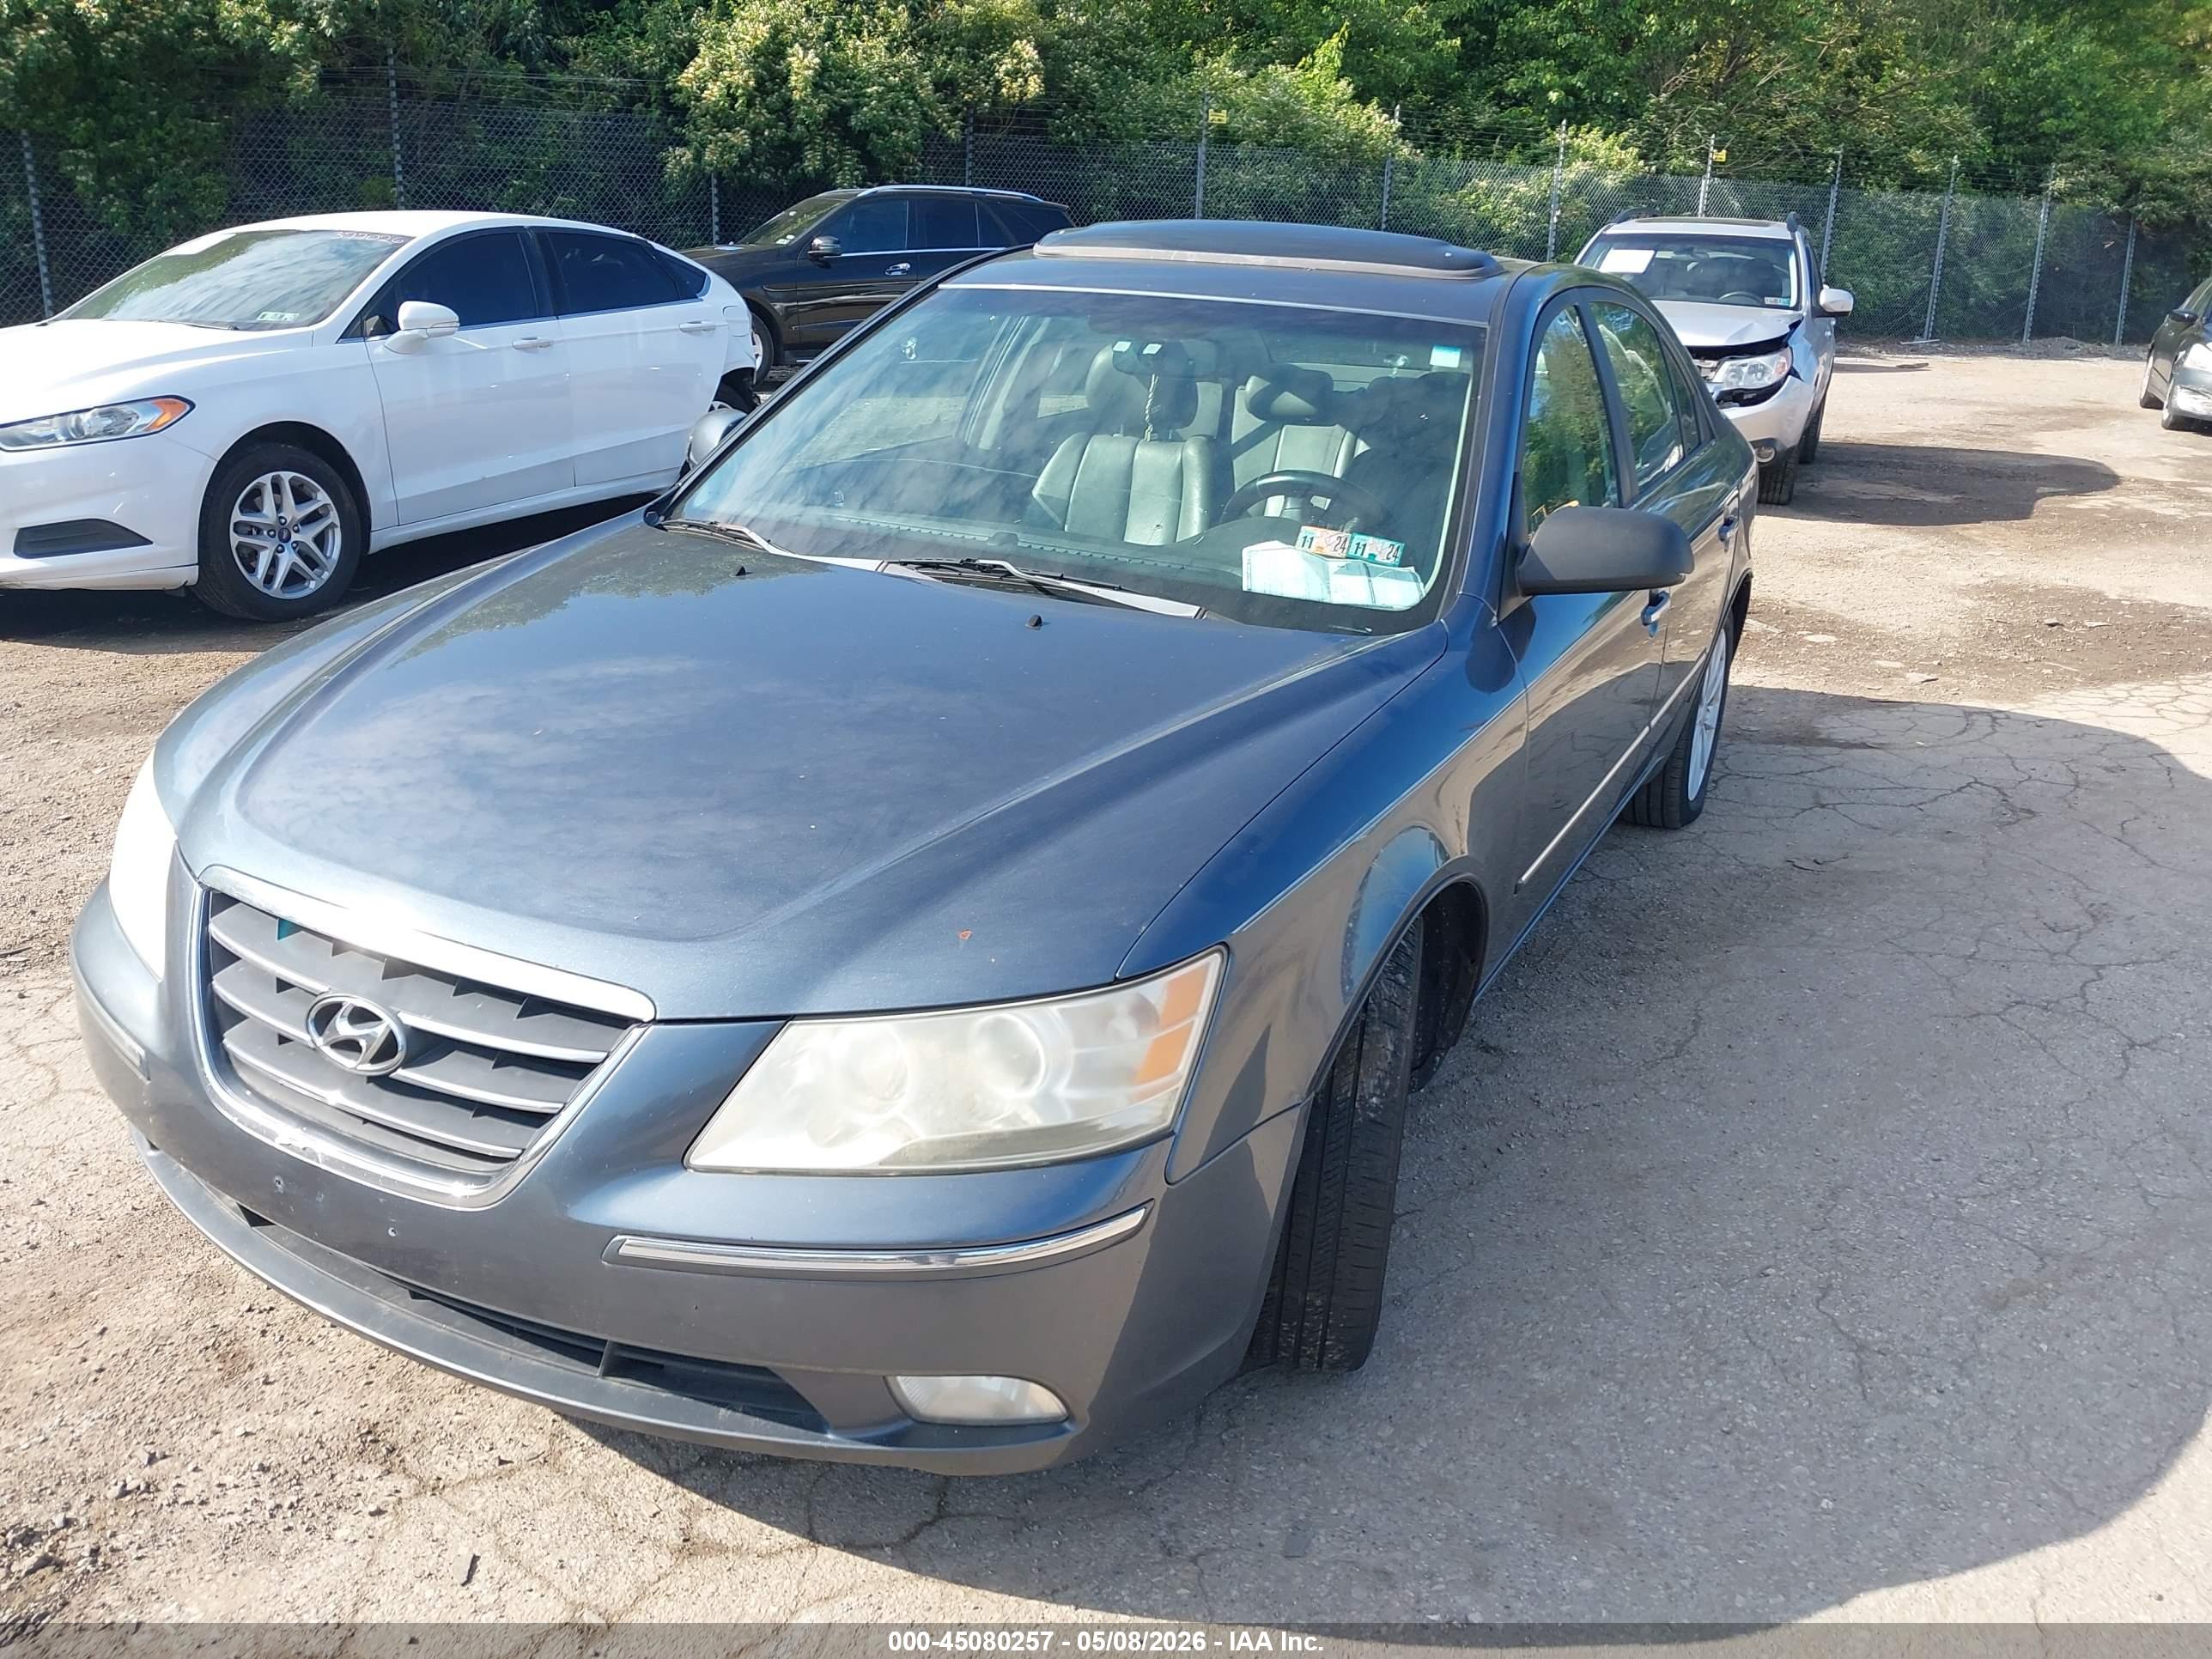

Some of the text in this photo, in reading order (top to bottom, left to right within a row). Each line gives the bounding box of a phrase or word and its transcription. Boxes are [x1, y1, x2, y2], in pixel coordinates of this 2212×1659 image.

[1302, 535, 1348, 554] 11 24
[1354, 542, 1401, 561] 11 24
